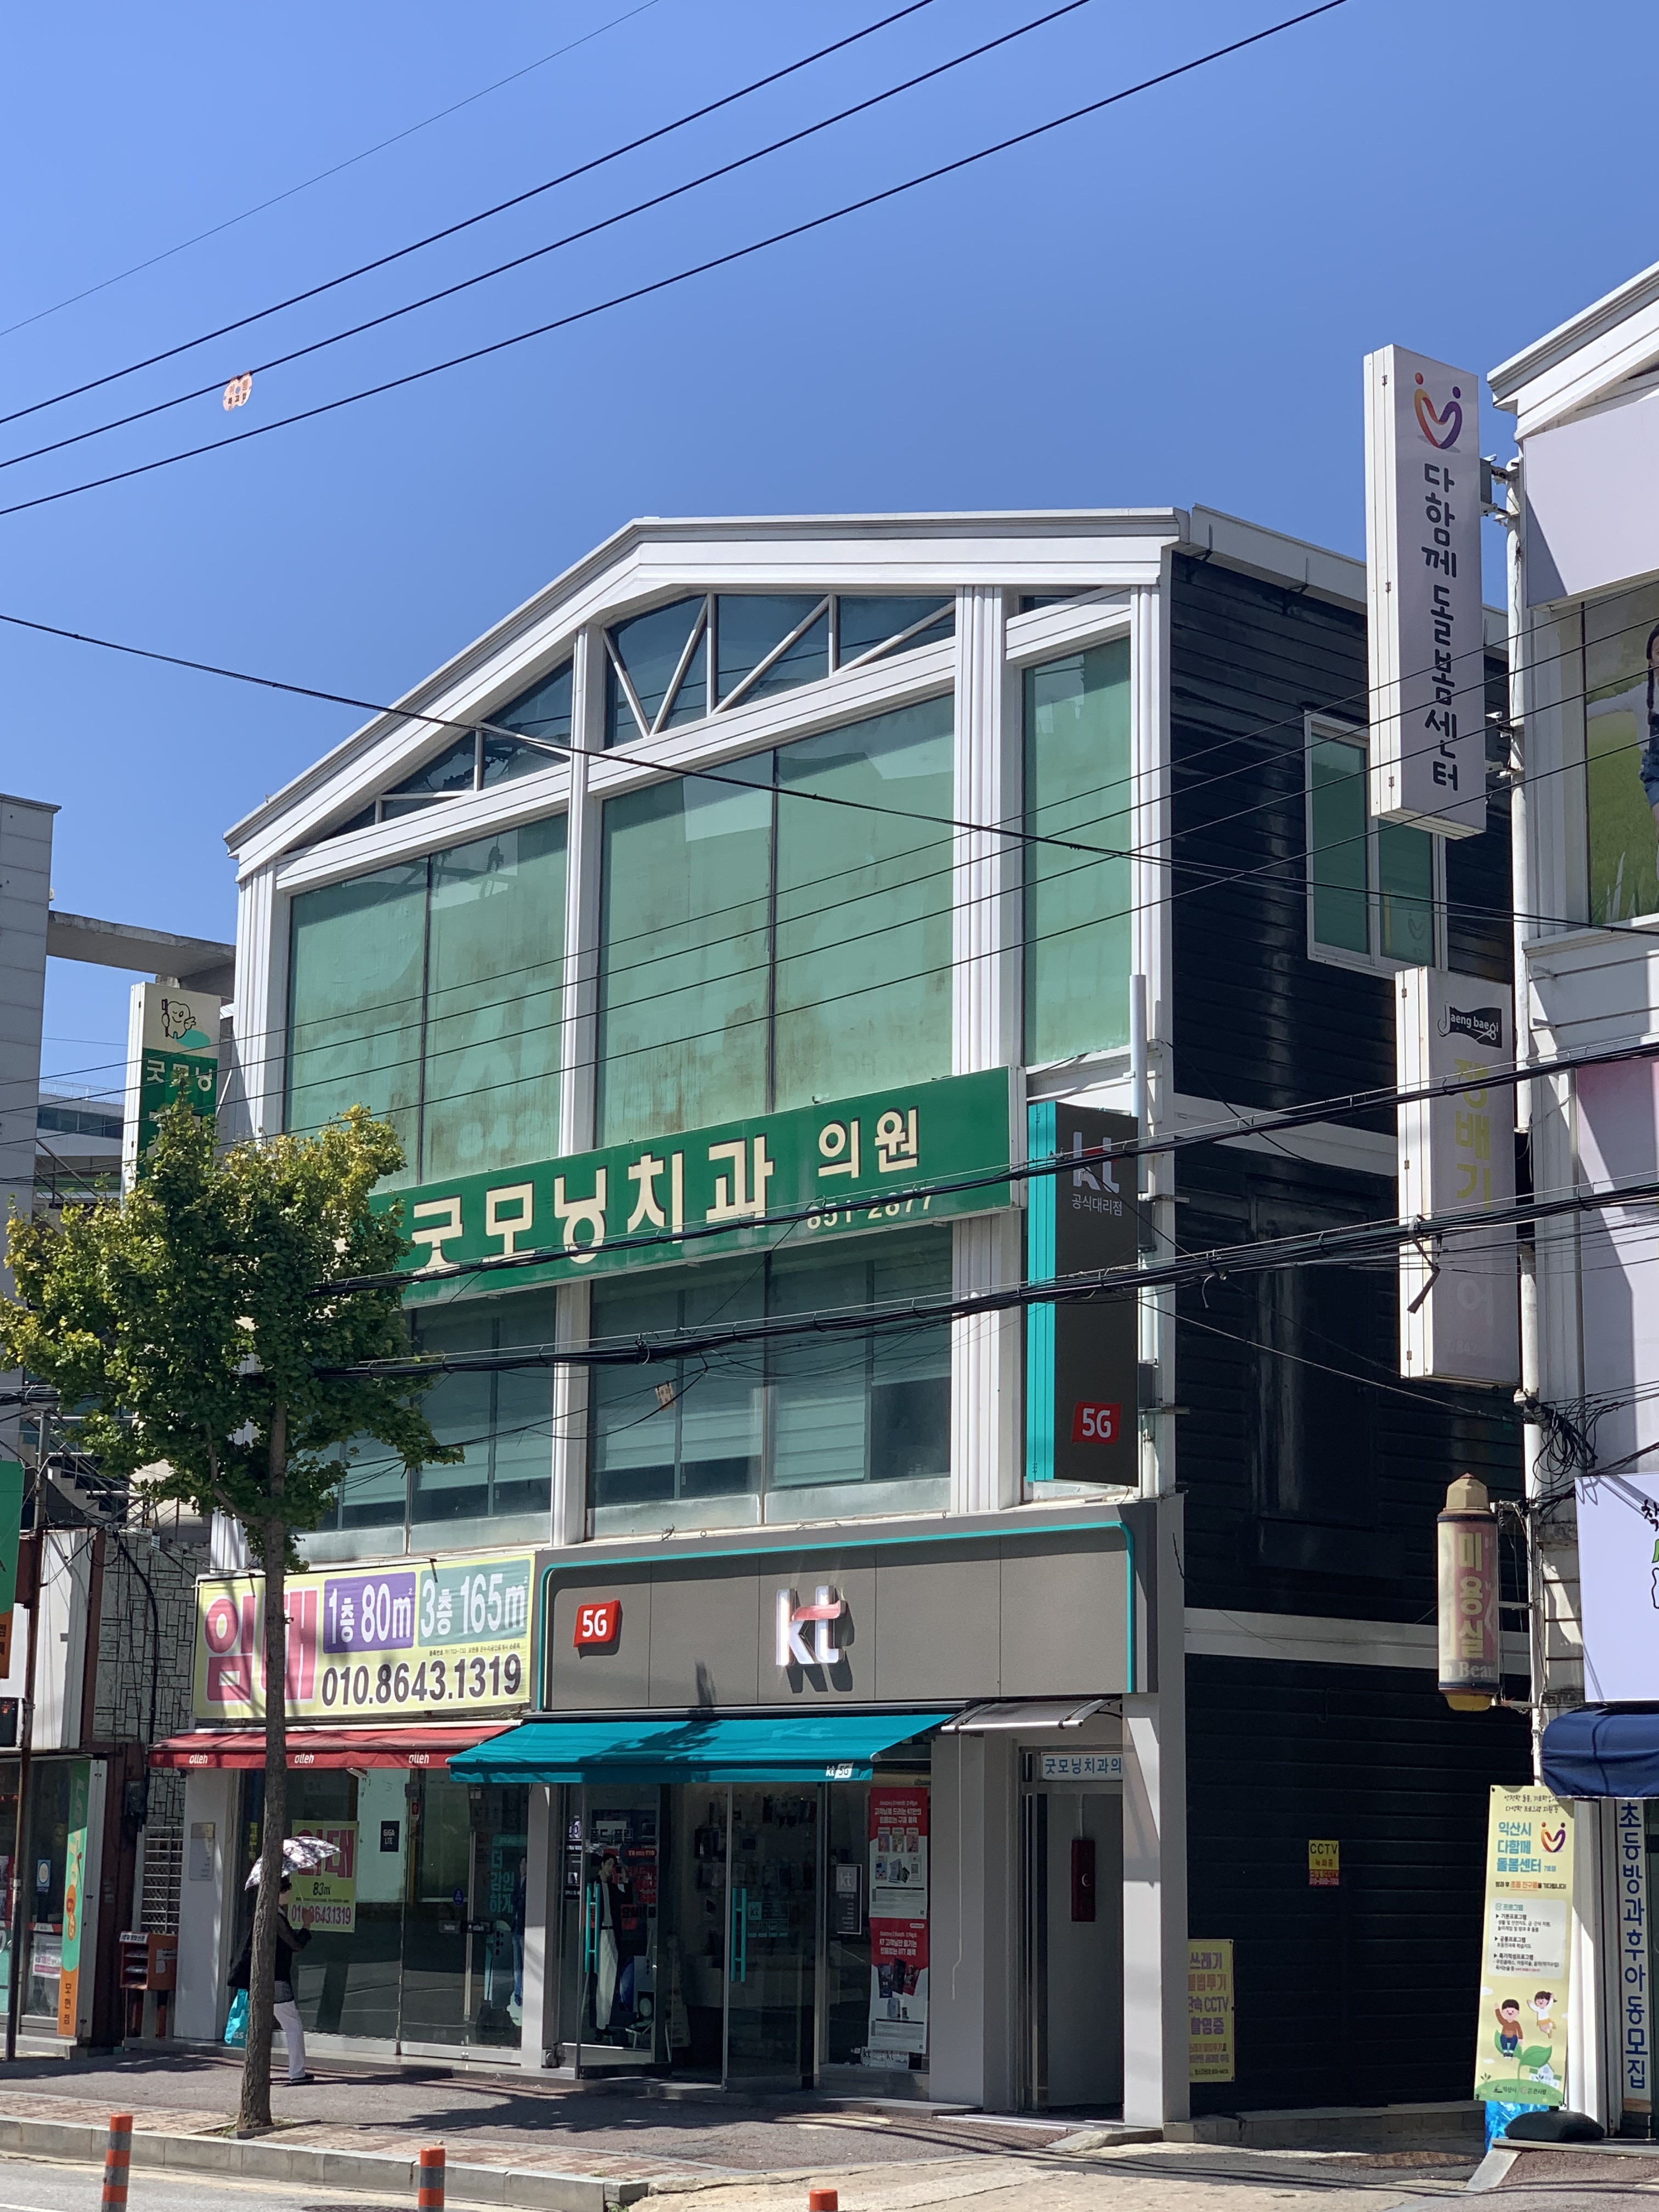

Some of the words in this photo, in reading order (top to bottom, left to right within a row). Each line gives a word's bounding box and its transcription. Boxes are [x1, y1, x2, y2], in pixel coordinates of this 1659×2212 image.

[411, 1135, 775, 1284] 굿모닝치과
[818, 1105, 919, 1178] 의원
[1071, 1193, 1122, 1216] 공식대리점
[1082, 1408, 1111, 1438] 5G
[1458, 1532, 1483, 1658] 미용실
[582, 1609, 607, 1637] 5G
[776, 1585, 847, 1666] kt
[321, 1654, 521, 1707] 010.8643.1319
[189, 1753, 208, 1765] olleh
[295, 1753, 314, 1764] olleh
[409, 1753, 429, 1764] olleh
[837, 1765, 851, 1776] 5G
[1498, 1821, 1532, 1836] 익산시
[1310, 1843, 1338, 1855] CCTV
[1497, 1839, 1531, 1854] 다함께
[1497, 1858, 1541, 1872] 돌봄센터
[1189, 1951, 1222, 1970] 쓰레기
